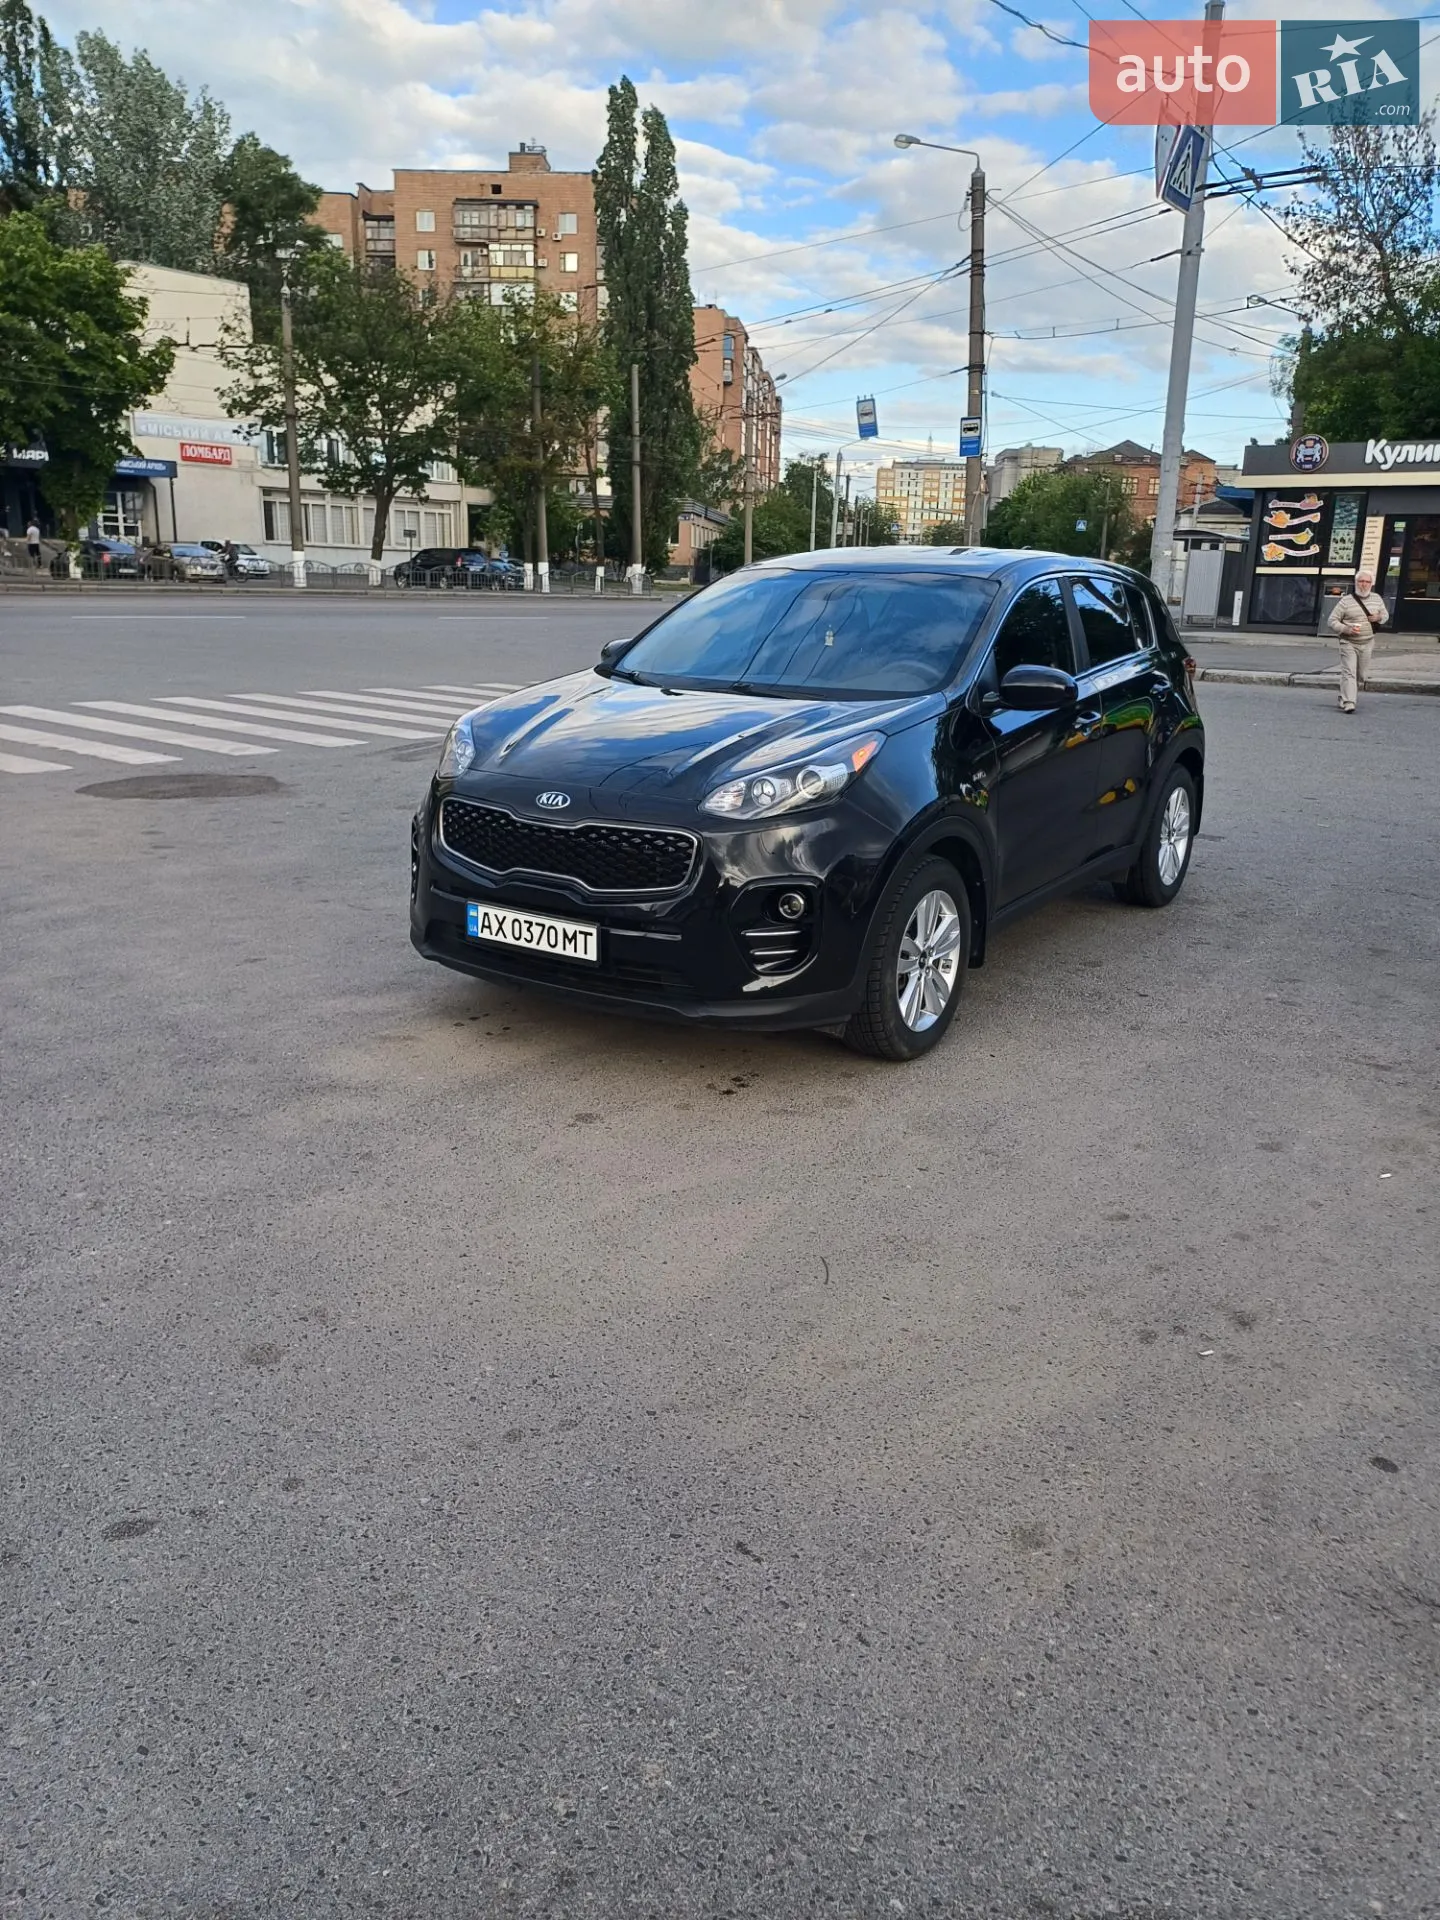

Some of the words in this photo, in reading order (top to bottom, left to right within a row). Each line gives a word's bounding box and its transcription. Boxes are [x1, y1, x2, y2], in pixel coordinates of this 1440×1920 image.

[182, 444, 231, 462] ЛОМБАРД
[539, 793, 564, 806] KIA
[480, 912, 507, 939] AX
[511, 918, 558, 949] 0370
[562, 927, 594, 956] MT
